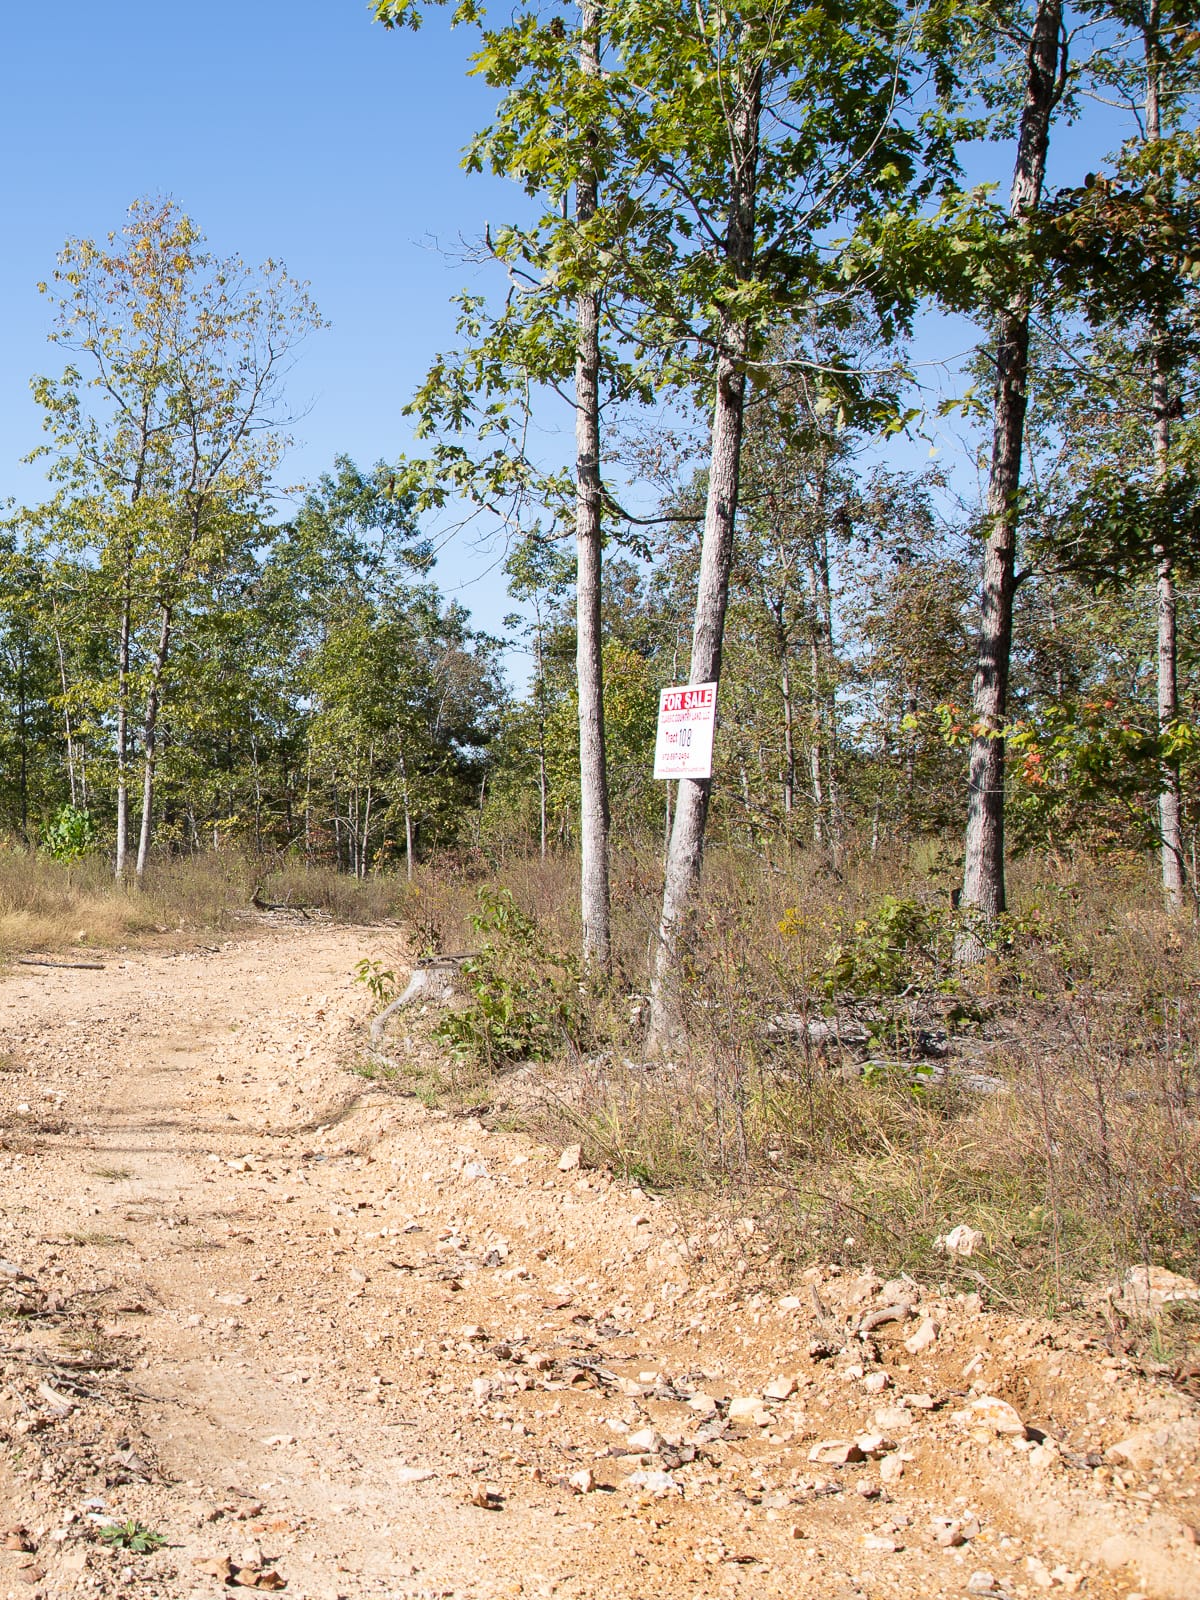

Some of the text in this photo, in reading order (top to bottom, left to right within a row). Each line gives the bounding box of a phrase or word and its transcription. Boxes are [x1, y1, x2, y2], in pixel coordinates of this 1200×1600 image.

[662, 690, 712, 711] FOR SALE
[666, 728, 692, 747] Tract 108
